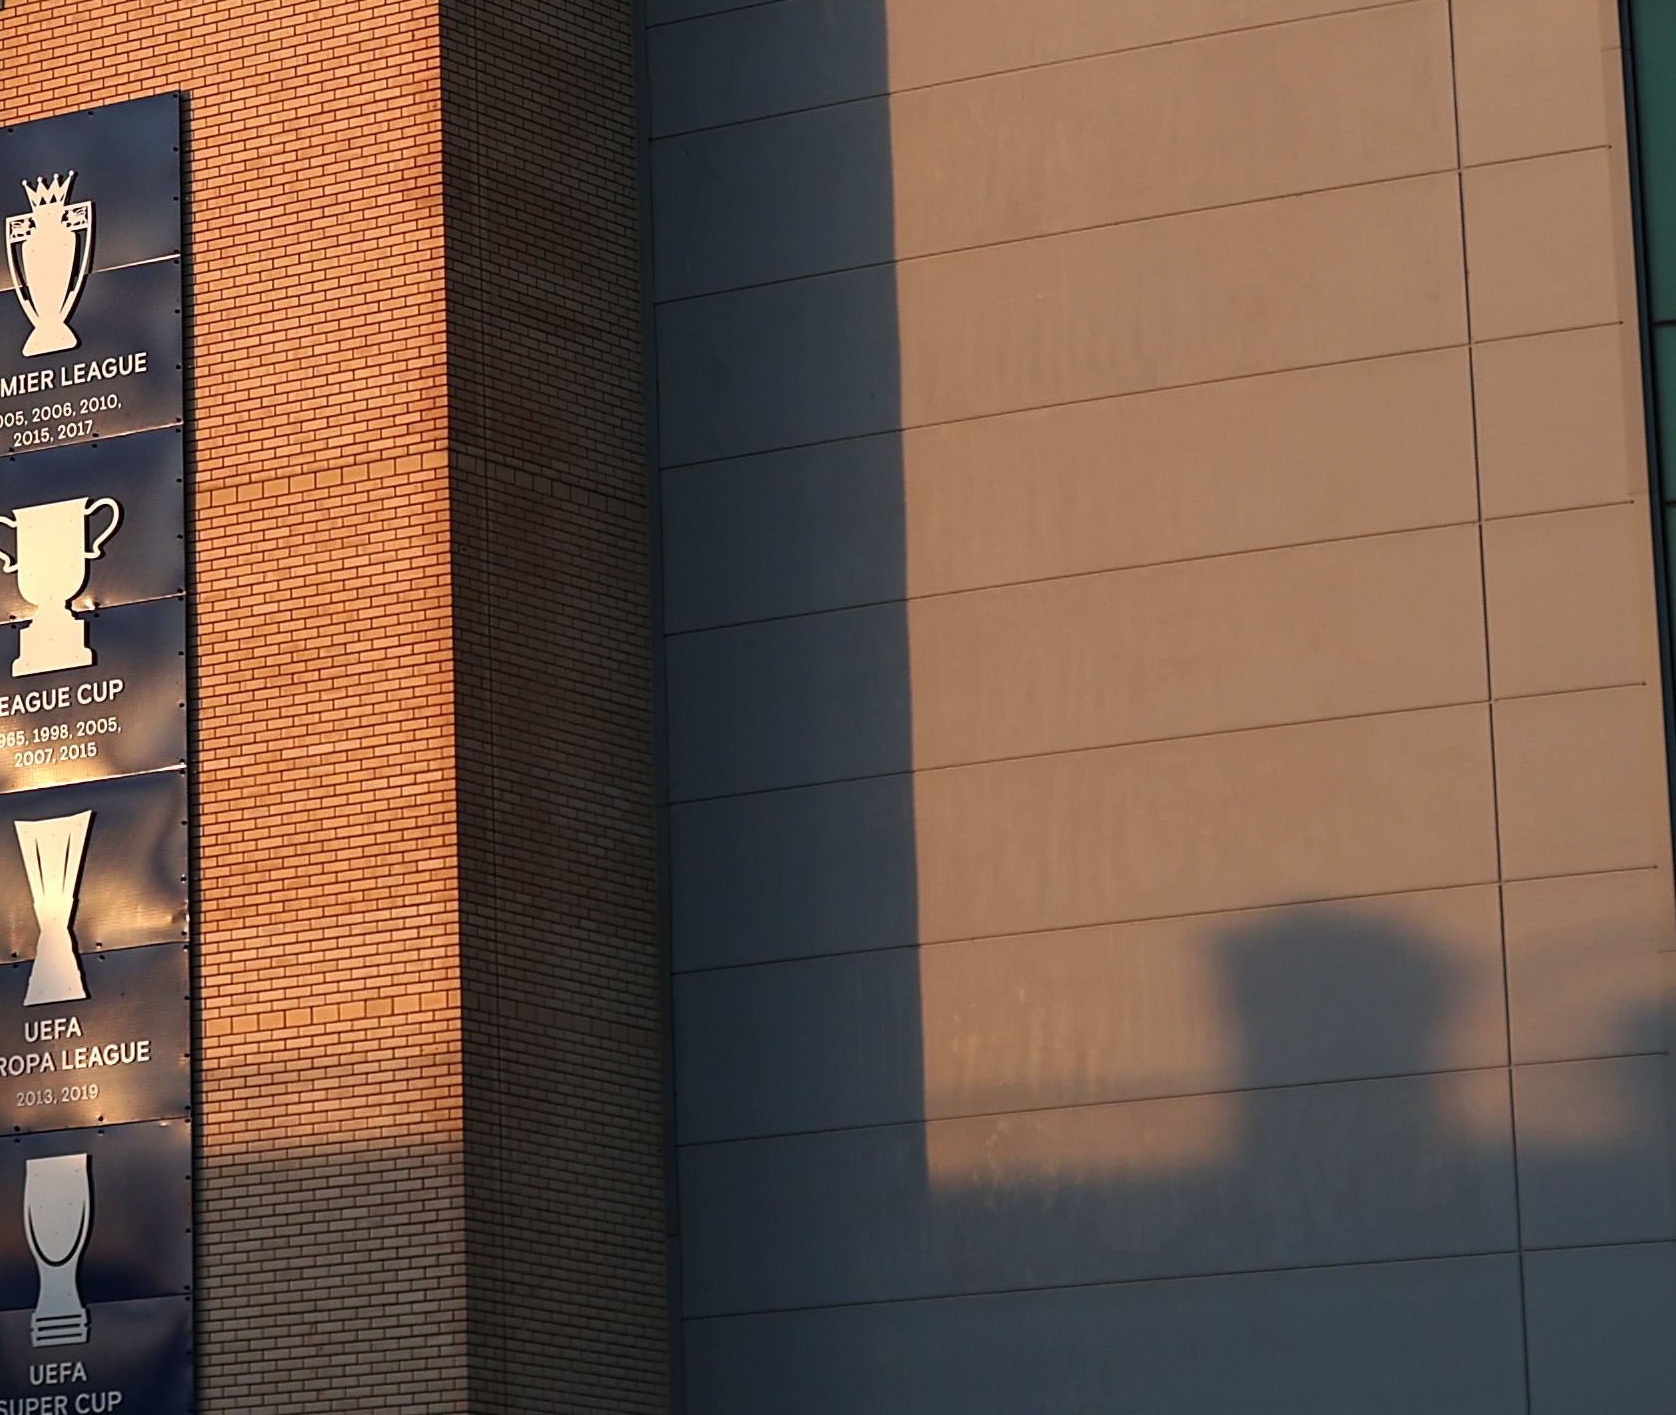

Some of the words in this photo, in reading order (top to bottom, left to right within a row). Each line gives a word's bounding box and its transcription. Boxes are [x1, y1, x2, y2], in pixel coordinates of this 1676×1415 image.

[61, 352, 148, 386] LEAGUE
[32, 402, 76, 423] 2006,
[80, 394, 122, 414] 2010,
[13, 426, 54, 447] 2015,
[58, 420, 93, 440] 2017
[77, 679, 124, 705] CUP
[33, 724, 73, 743] 1998,
[76, 717, 122, 736] 2005,
[14, 748, 56, 768] 2007,
[59, 742, 97, 761] 2015
[24, 1016, 83, 1043] UEFA
[61, 1040, 151, 1071] LEAGUE
[17, 1088, 58, 1107] 2013,
[61, 1084, 99, 1102] 2019
[29, 1361, 87, 1386] UEFA
[75, 1391, 122, 1415] CUP
